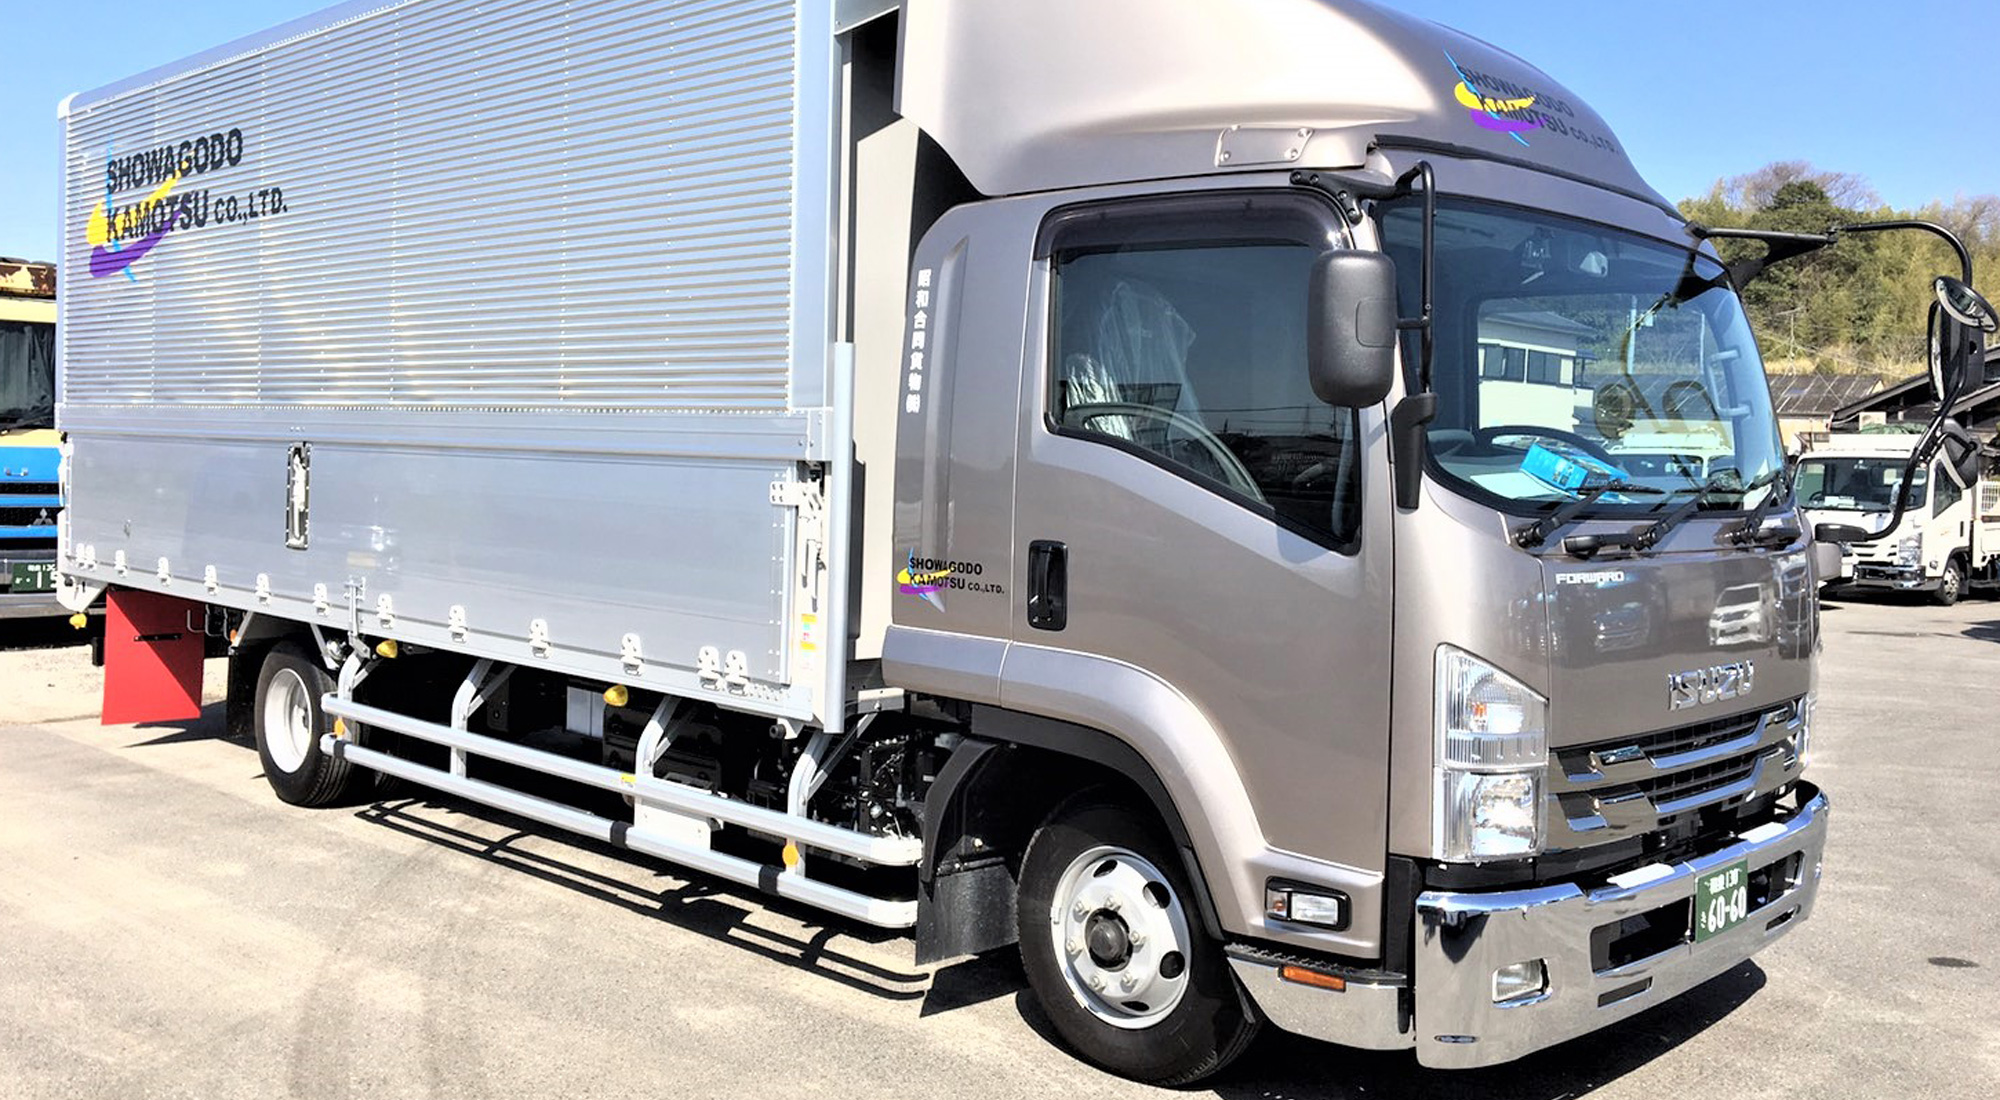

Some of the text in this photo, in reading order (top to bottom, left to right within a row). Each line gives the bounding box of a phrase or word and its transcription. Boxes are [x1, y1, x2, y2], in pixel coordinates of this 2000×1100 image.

[106, 127, 243, 195] SHOWAGODO
[106, 187, 288, 242] KAMOTSU CO.,LTD.
[909, 557, 983, 575] SHOWAGODO
[910, 573, 965, 590] KAMOTSU
[1556, 570, 1625, 585] FORWARD
[1667, 660, 1754, 712] ISUZU
[1708, 886, 1747, 933] 60-60
